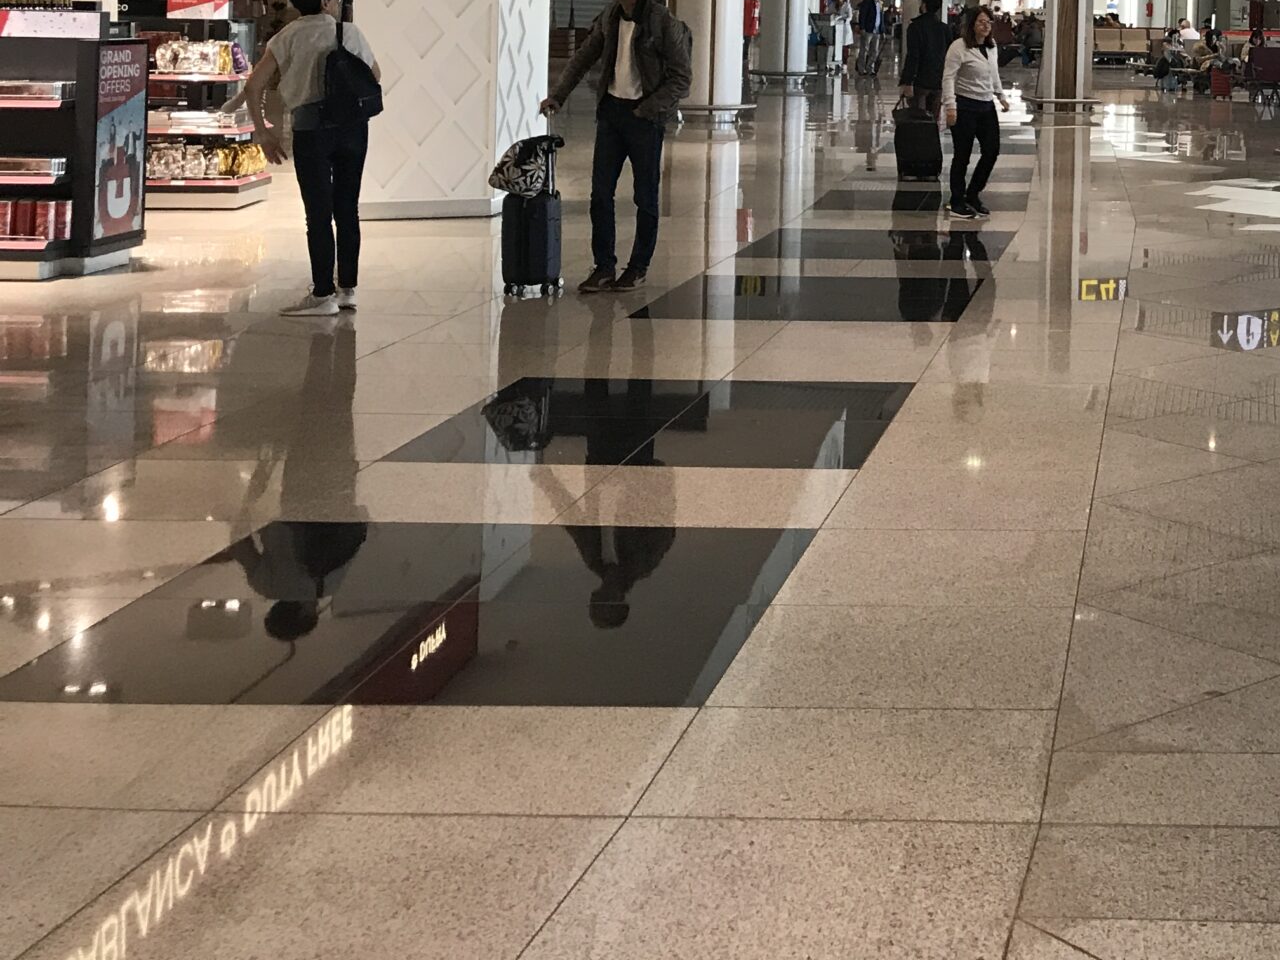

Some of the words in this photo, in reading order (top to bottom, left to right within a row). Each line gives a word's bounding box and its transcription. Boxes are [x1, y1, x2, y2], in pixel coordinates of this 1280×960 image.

[100, 50, 132, 64] GRAND
[100, 63, 140, 79] OPENING
[99, 79, 131, 94] OFFERS
